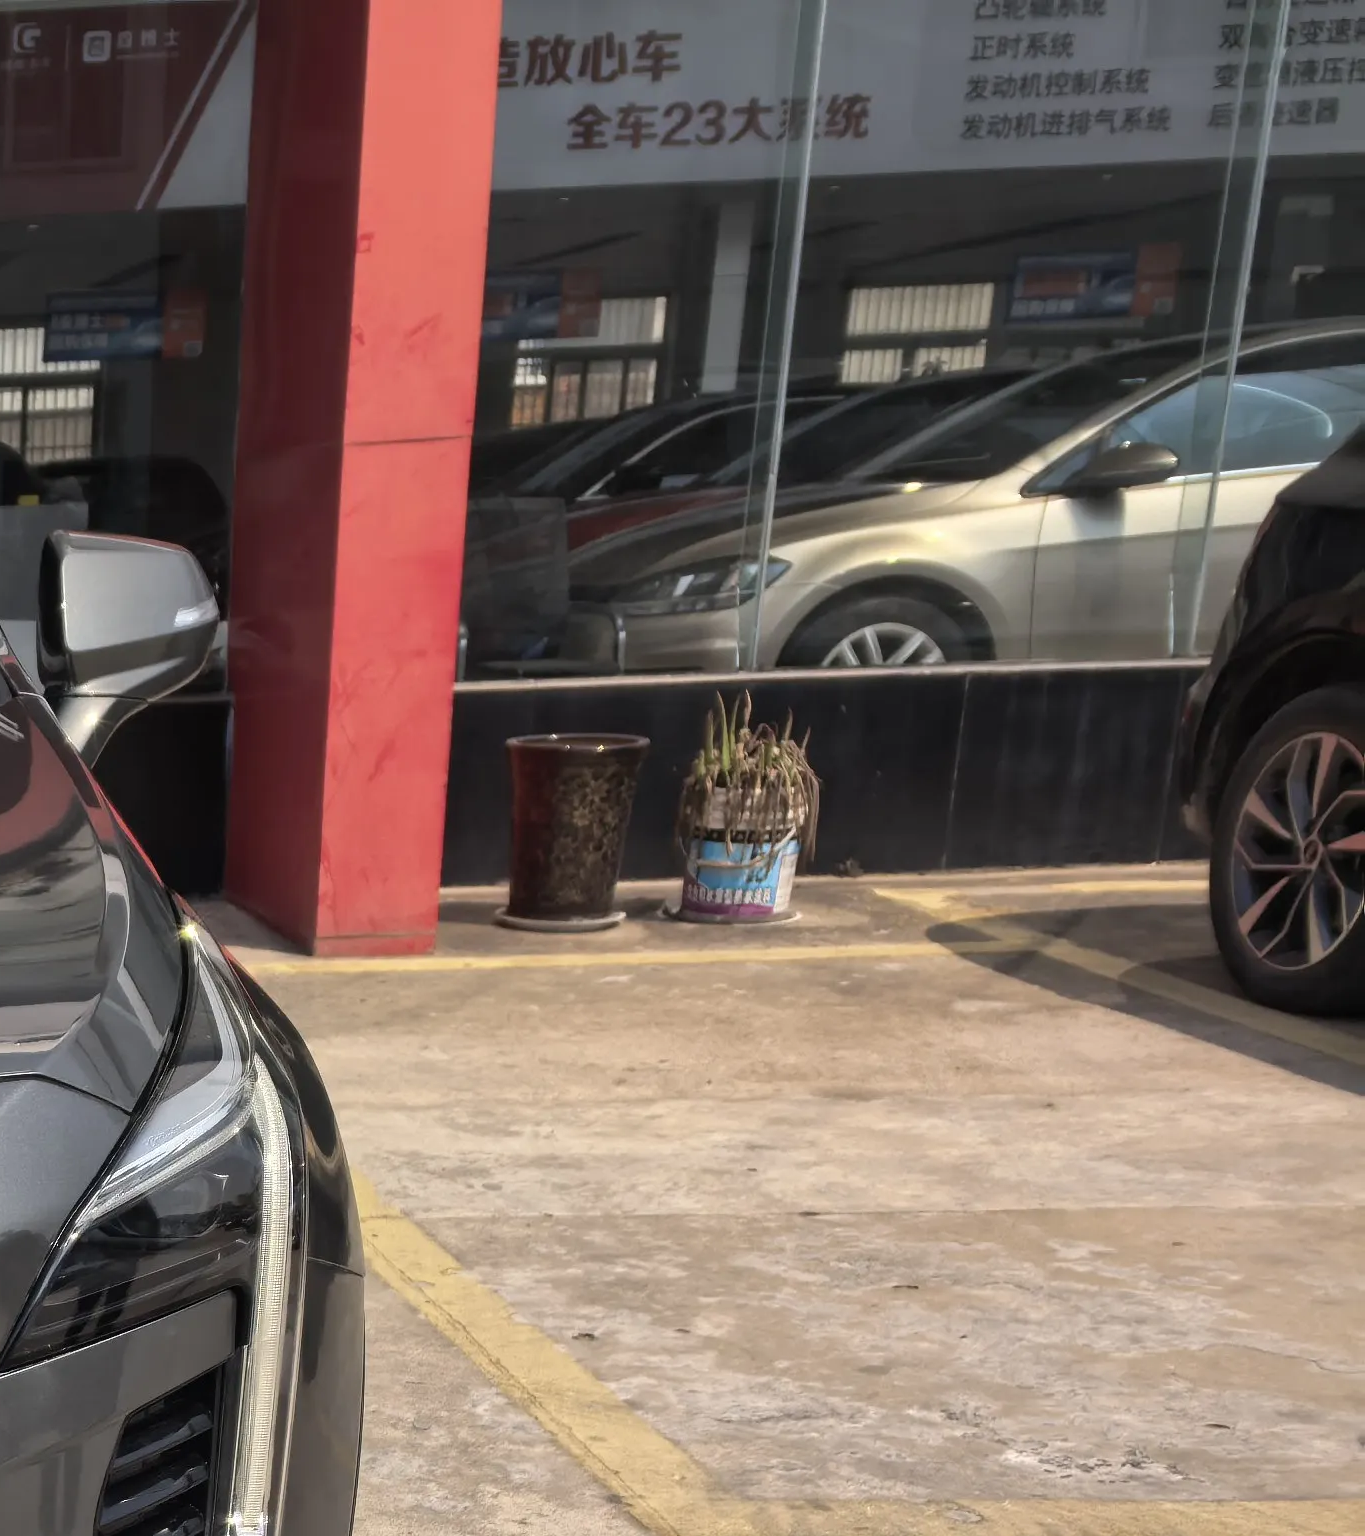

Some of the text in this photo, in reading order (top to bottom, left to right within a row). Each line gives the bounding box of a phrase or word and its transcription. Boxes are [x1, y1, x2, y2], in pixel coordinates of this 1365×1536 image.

[969, 30, 1076, 60] 正时系统
[965, 68, 1151, 101] 发动机控制系统
[566, 94, 872, 150] 全车23大系统
[960, 105, 1171, 139] 发动机进排气系统
